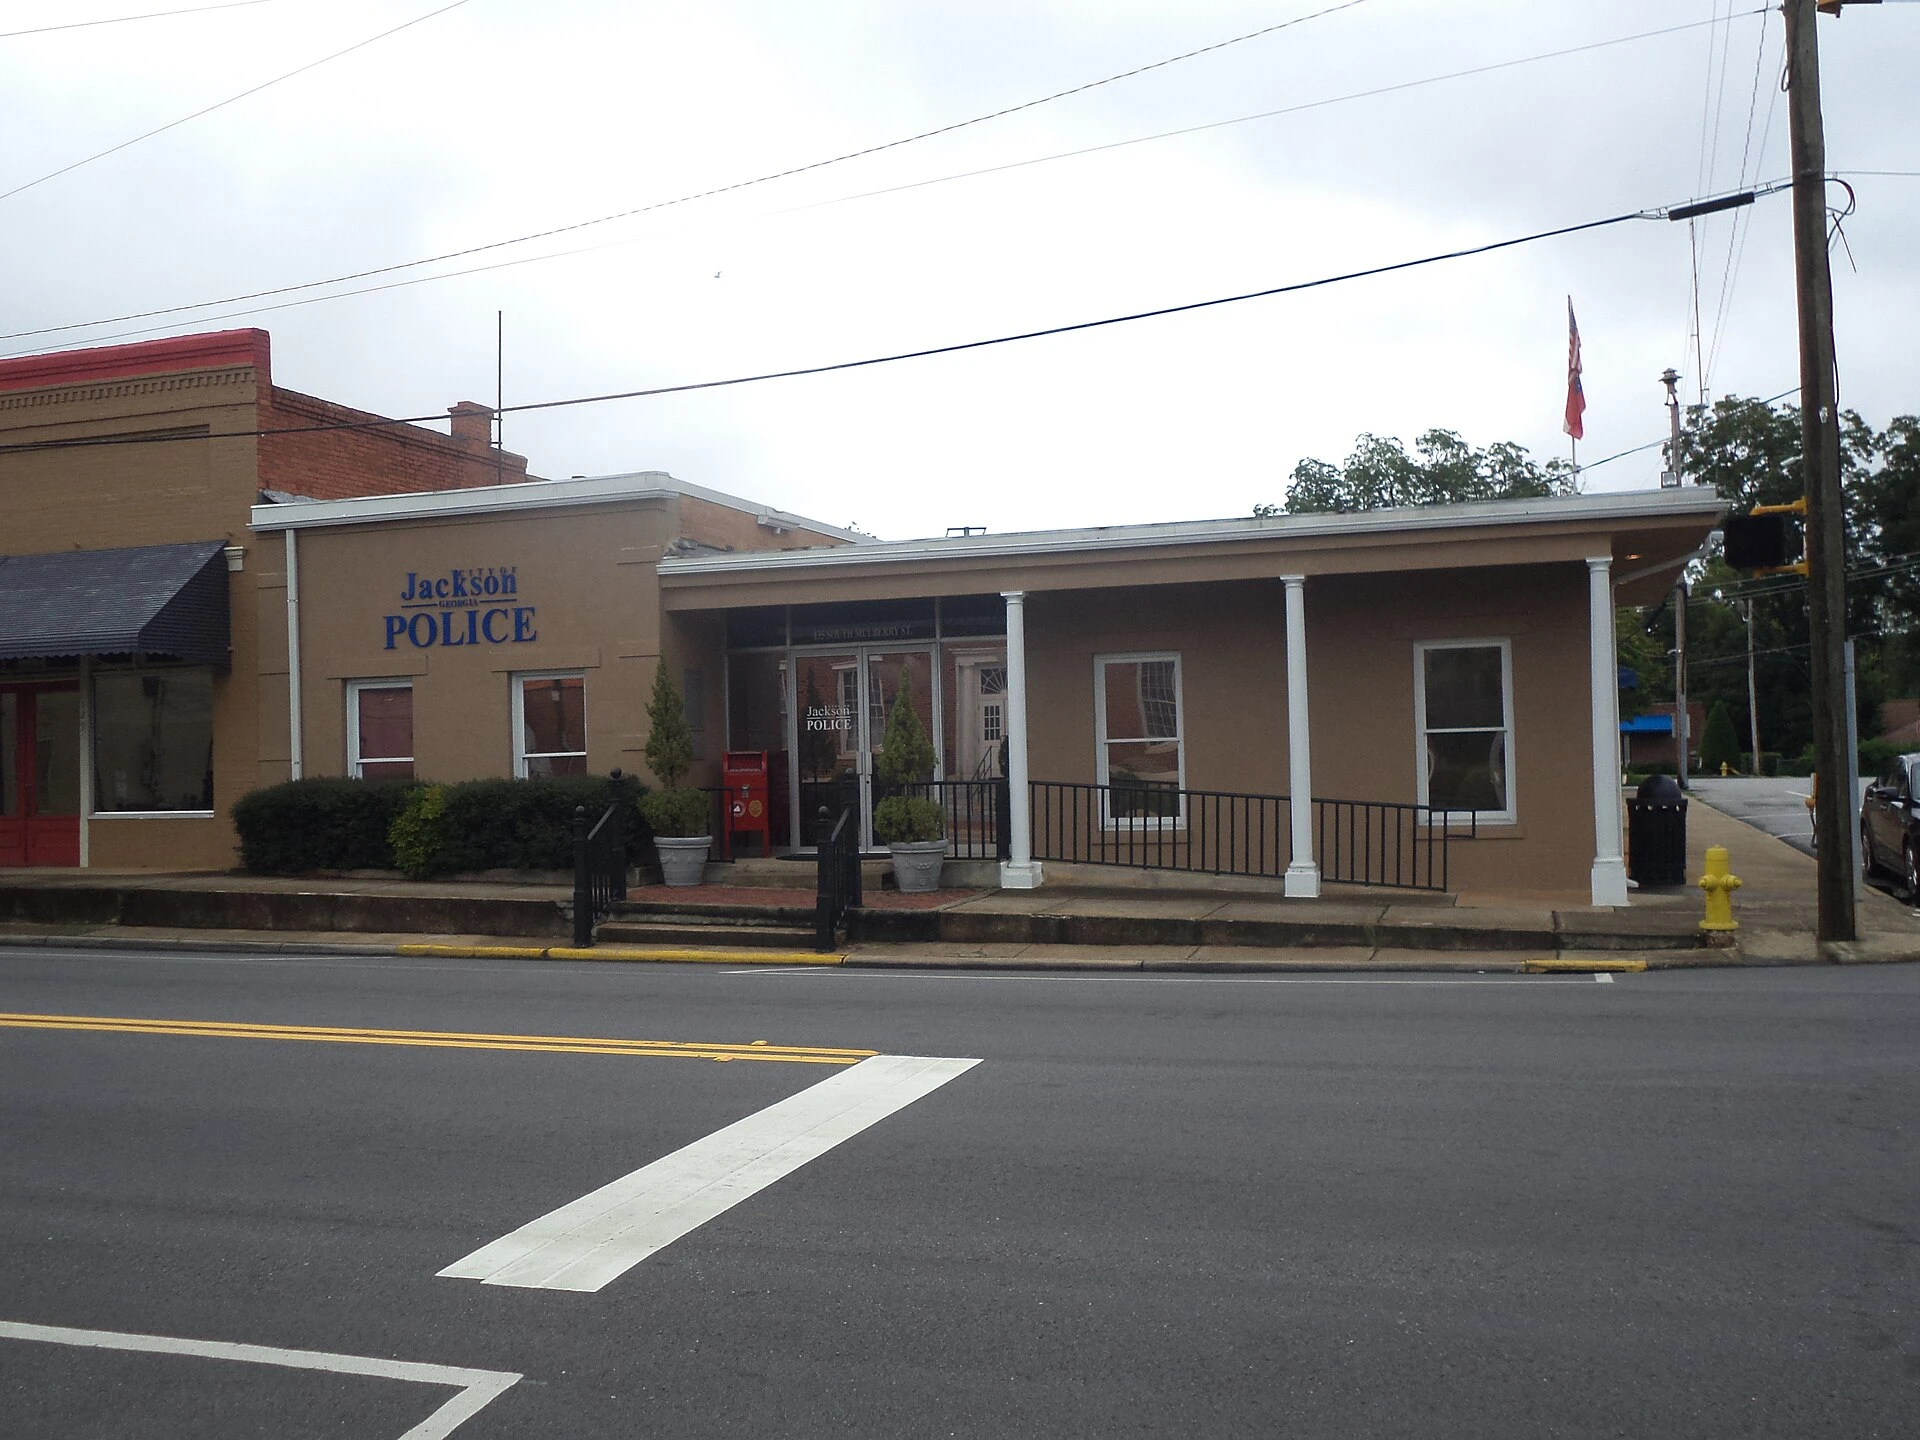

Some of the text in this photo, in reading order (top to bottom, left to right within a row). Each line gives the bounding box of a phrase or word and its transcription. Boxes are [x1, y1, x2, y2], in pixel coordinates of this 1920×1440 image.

[458, 565, 518, 576] CITY OF
[401, 569, 518, 601] Jackson
[438, 598, 479, 608] GEORGIA
[383, 606, 538, 650] POLICE
[826, 628, 853, 640] SOUTH
[855, 626, 898, 639] MULBERRY
[807, 705, 850, 717] Jackson
[807, 719, 852, 731] POLICE
